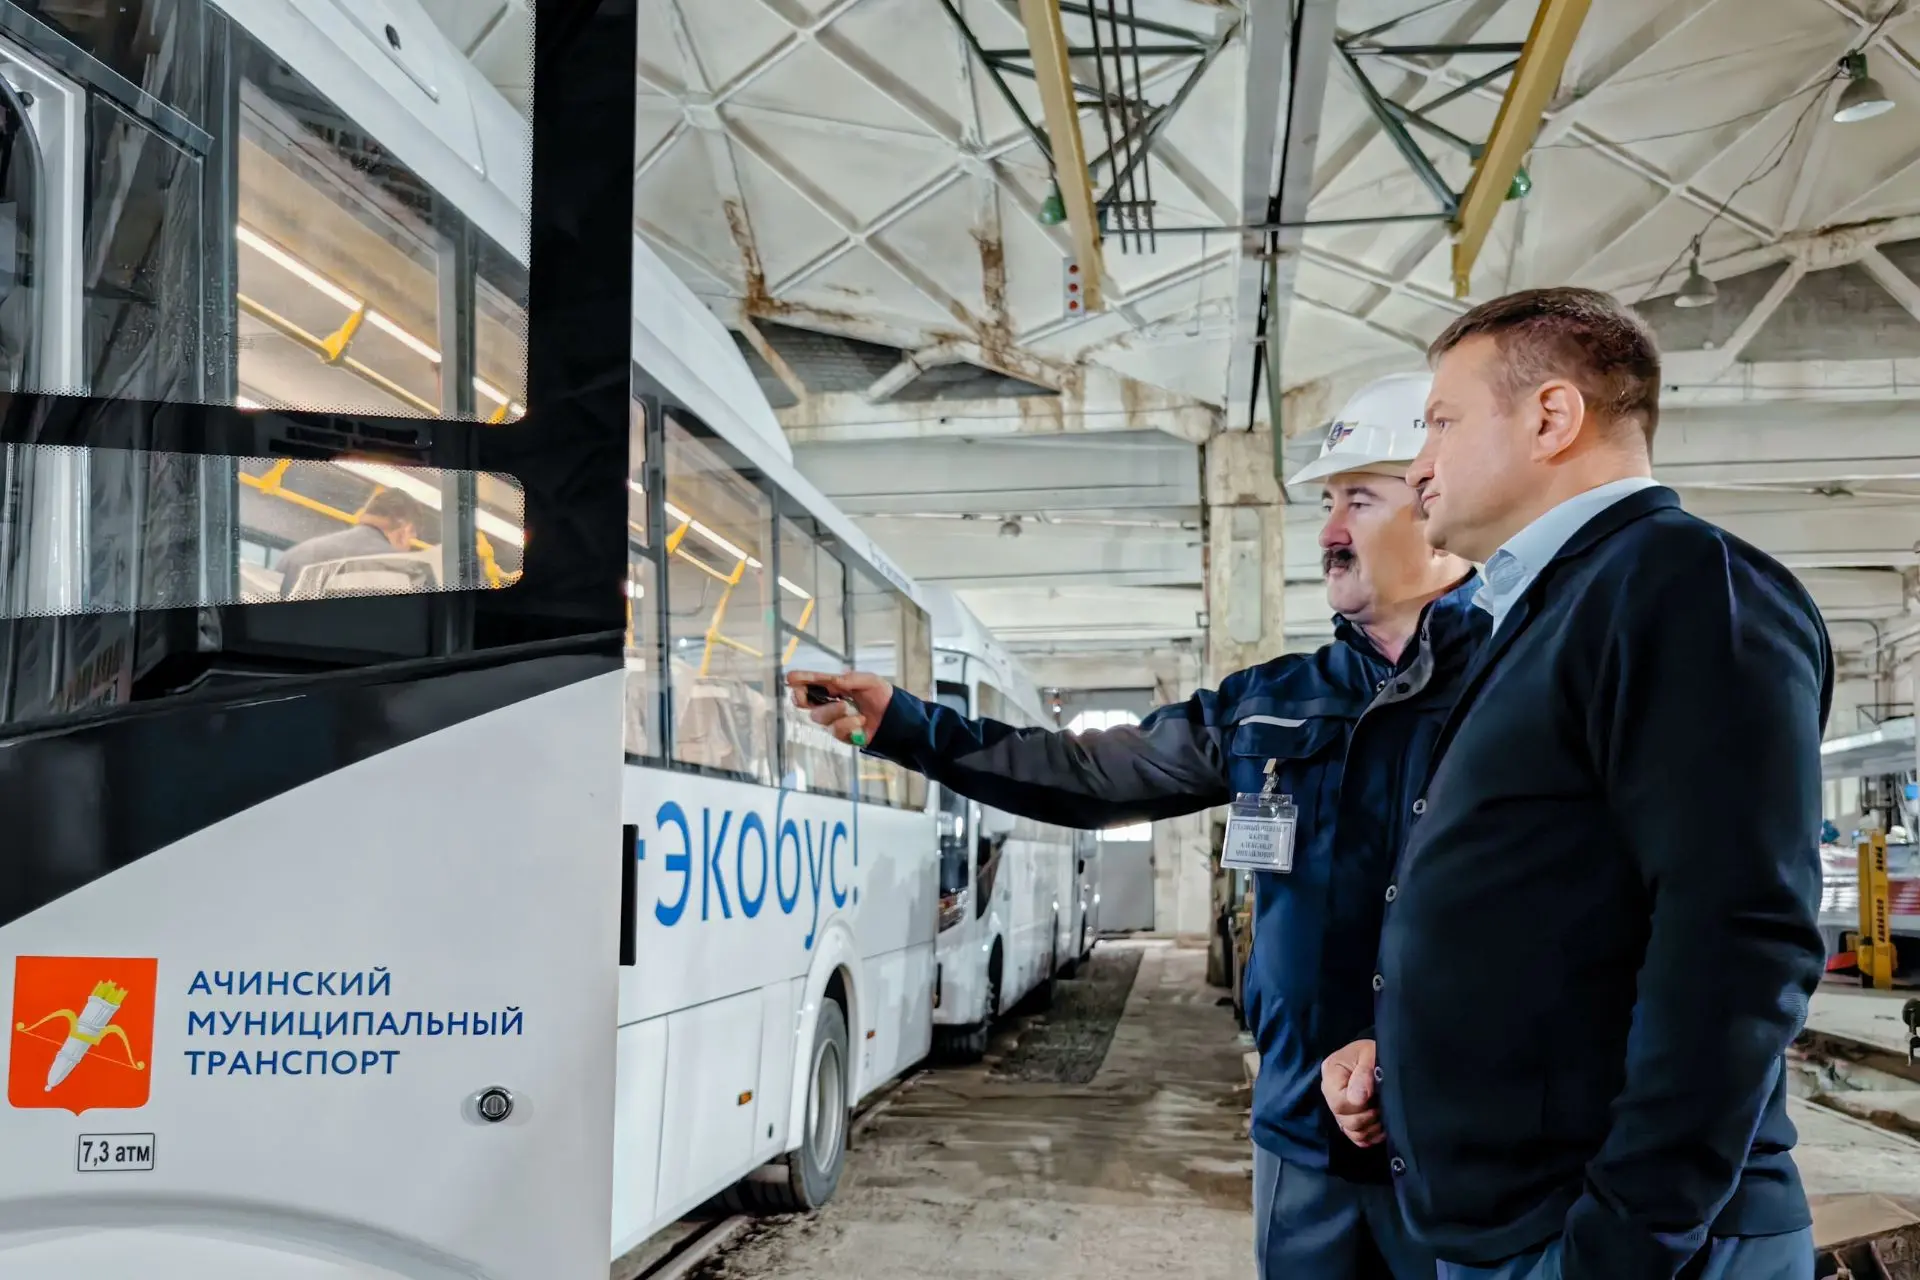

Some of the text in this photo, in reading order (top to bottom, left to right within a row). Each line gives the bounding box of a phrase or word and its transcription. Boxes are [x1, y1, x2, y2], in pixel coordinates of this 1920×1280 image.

[188, 967, 392, 996] АЧИНСКИЙ
[187, 1007, 524, 1039] МУНИЦИПАЛЬНЫЙ
[184, 1050, 400, 1076] ТРАНСПОРТ
[83, 1141, 150, 1166] 7,3 атм
